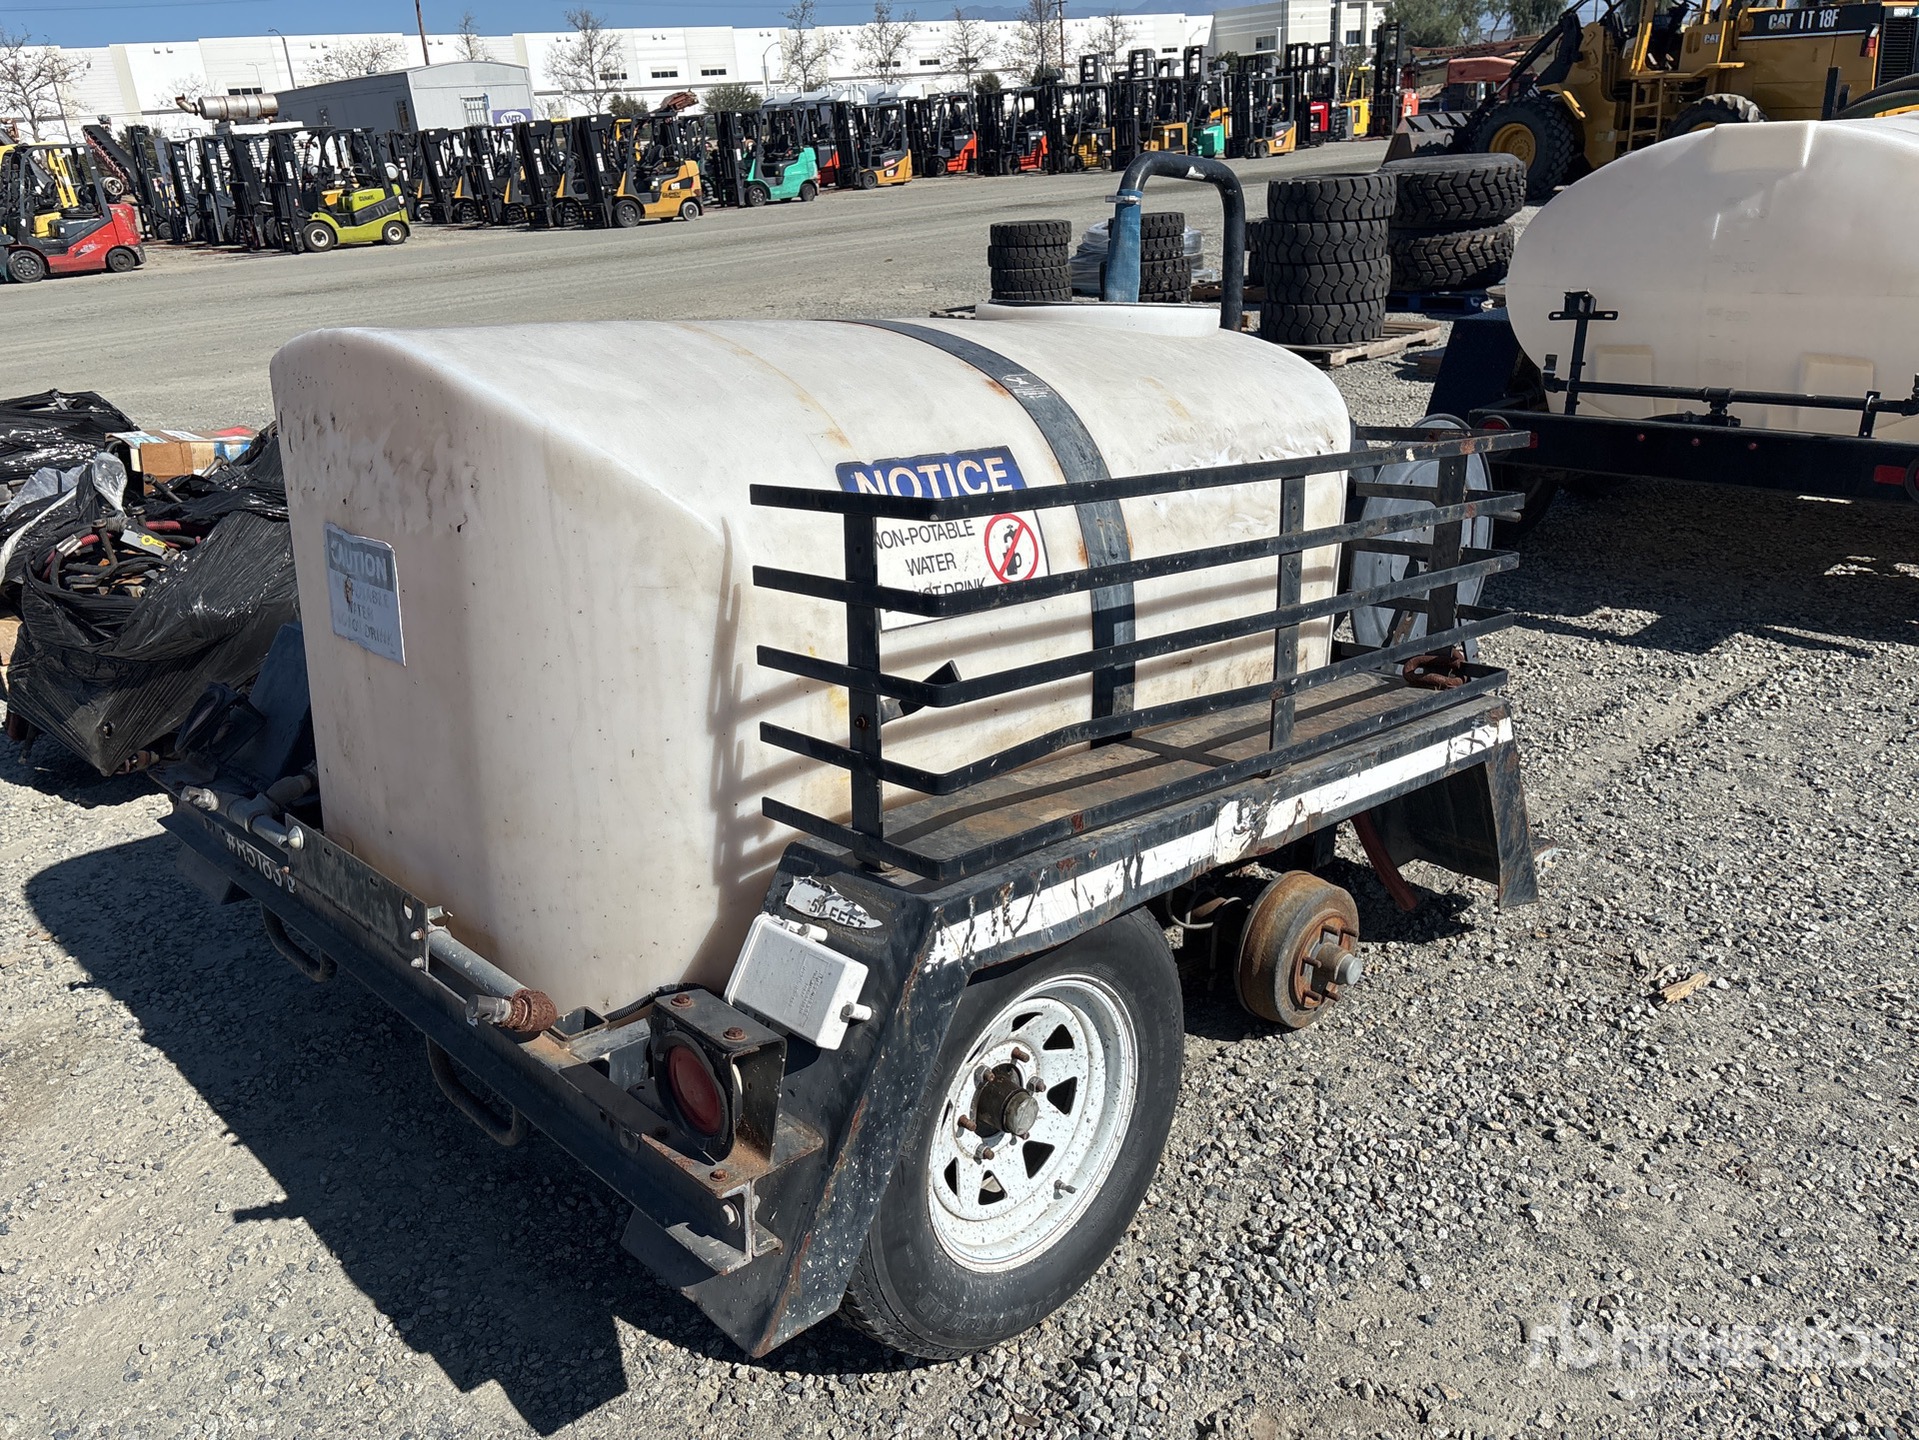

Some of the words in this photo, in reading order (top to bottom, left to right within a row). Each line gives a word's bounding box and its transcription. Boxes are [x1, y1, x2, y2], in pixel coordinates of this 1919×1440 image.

[1768, 12, 1794, 30] CAT
[1818, 8, 1841, 28] 18F
[1703, 33, 1720, 45] CAT
[854, 456, 1014, 499] NOTICE
[875, 519, 976, 550] NON-POTABLE
[330, 540, 388, 582] CAUTION
[905, 551, 958, 577] WATER
